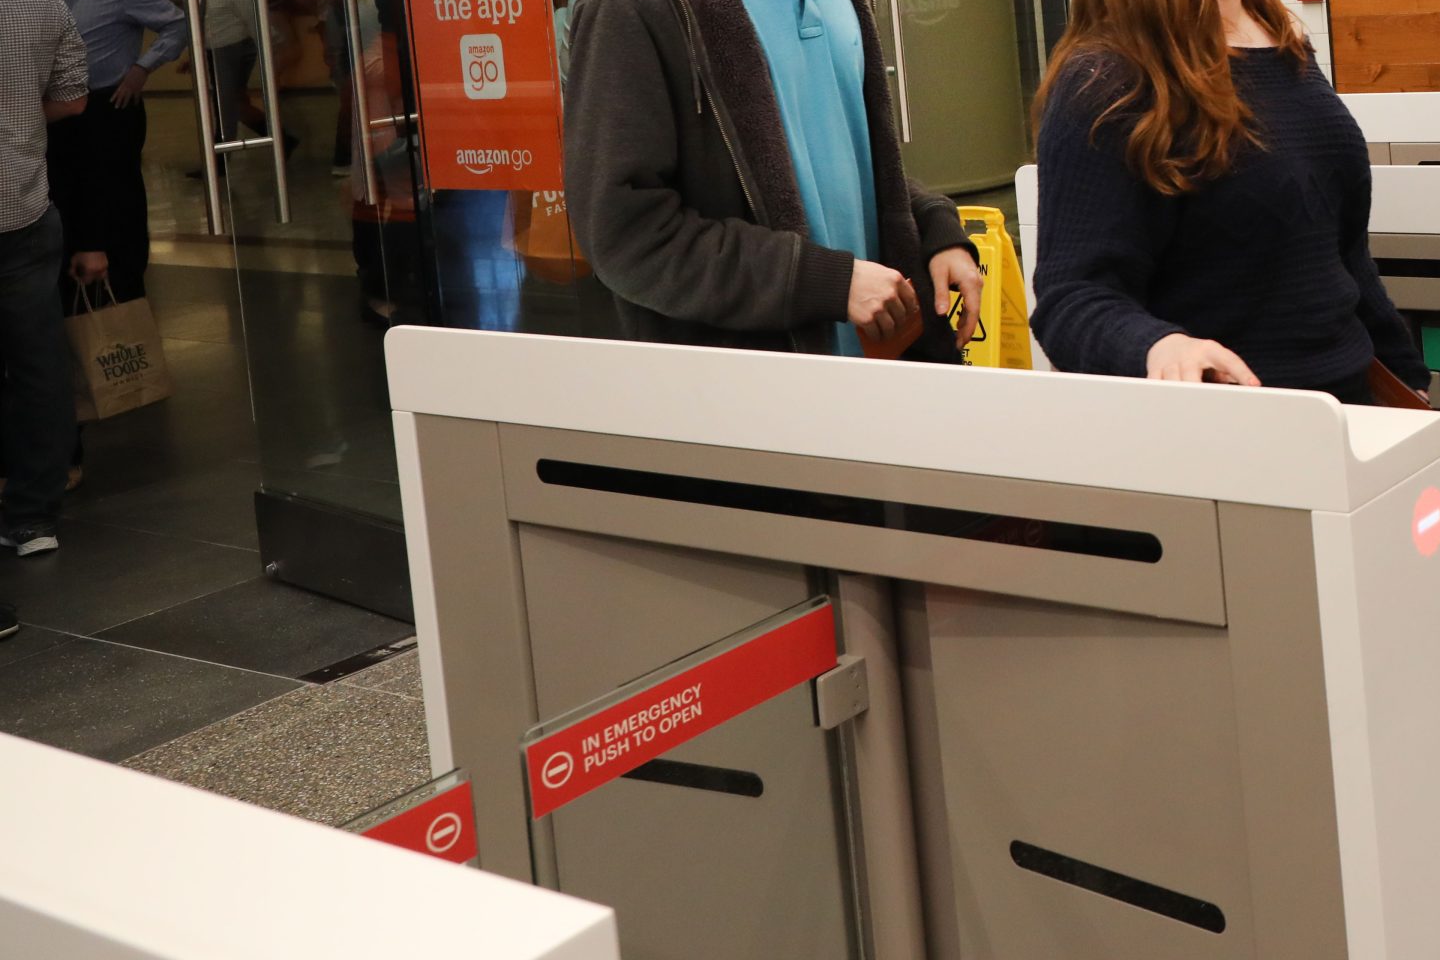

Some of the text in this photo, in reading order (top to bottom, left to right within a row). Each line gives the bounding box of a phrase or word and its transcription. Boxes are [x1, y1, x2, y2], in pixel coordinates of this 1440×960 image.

[468, 45, 495, 55] amazon
[469, 60, 498, 91] go
[456, 148, 532, 171] amazon go
[96, 343, 146, 368] WHOLE
[103, 356, 149, 381] FOODS
[582, 683, 702, 754] IN EMERGENCY
[583, 702, 702, 773] PUSH TO OPEN
